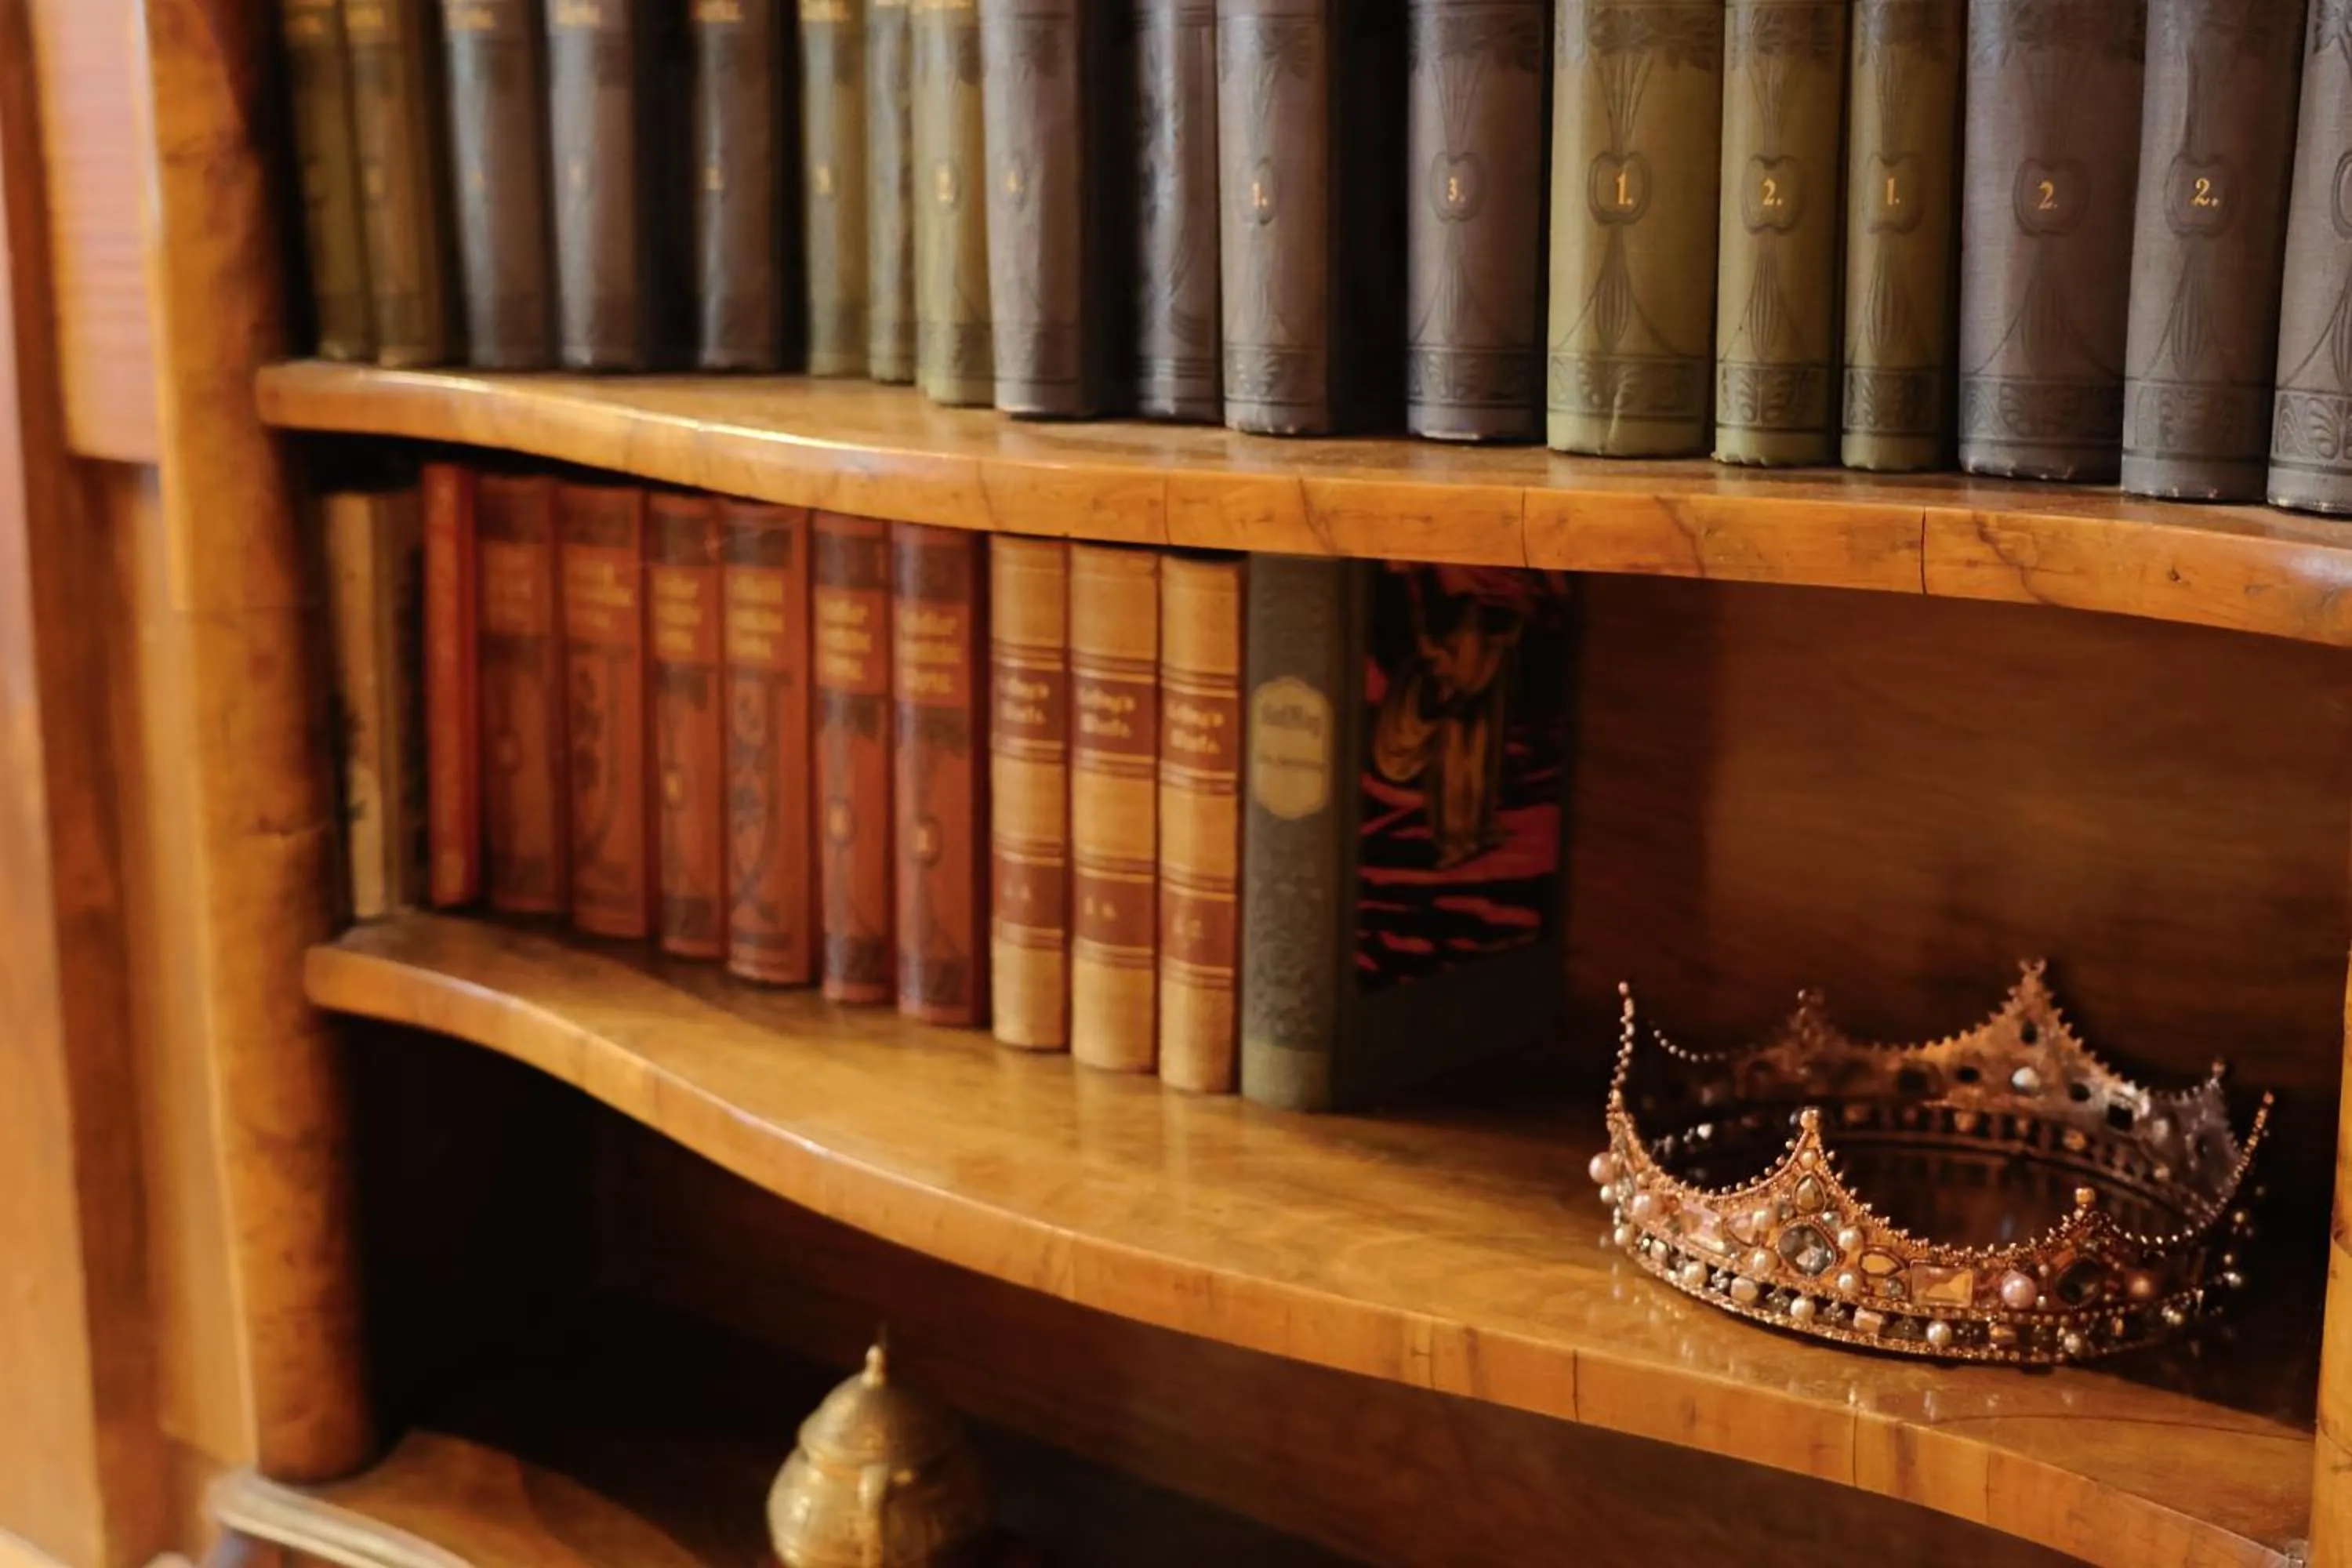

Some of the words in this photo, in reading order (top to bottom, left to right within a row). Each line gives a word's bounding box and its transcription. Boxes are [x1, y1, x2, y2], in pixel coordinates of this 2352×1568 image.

[1447, 177, 1465, 202] 3.
[1616, 172, 1633, 205] 1.
[1762, 178, 1783, 206] 2.
[1886, 177, 1900, 205] 1.
[2038, 180, 2058, 209] 2.
[2191, 177, 2220, 207] 2.
